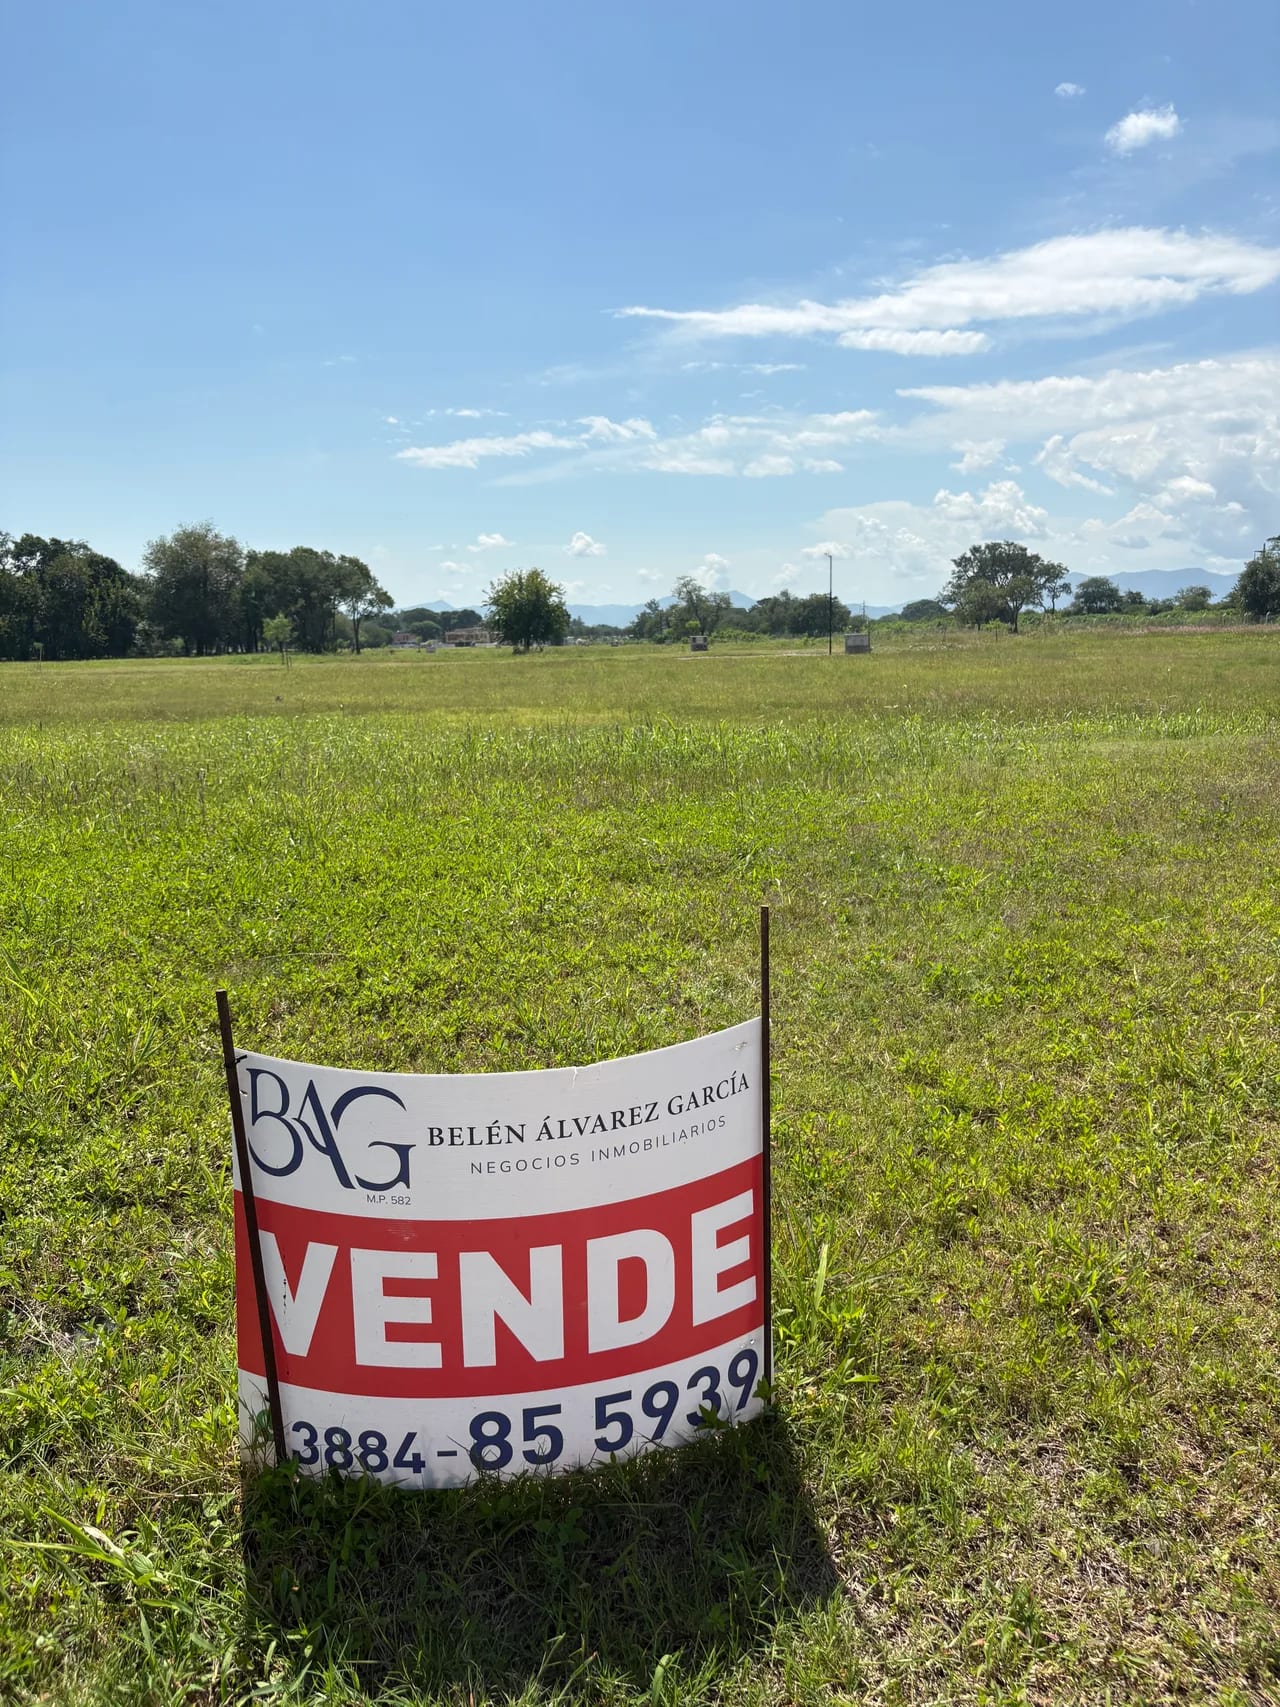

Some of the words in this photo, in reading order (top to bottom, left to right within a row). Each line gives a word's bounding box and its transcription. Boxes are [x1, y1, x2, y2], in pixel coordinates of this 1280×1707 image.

[246, 1067, 416, 1192] BAG
[427, 1120, 527, 1147] BELÉN
[535, 1101, 660, 1142] ÁLVAREZ
[667, 1070, 750, 1116] GARCÍA
[470, 1152, 581, 1175] NEGOCIOS
[591, 1115, 727, 1163] INMOBILIARIOS
[366, 1194, 388, 1204] M.P.
[391, 1195, 412, 1206] 582
[258, 1188, 757, 1369] VENDE
[594, 1348, 759, 1452] 5939
